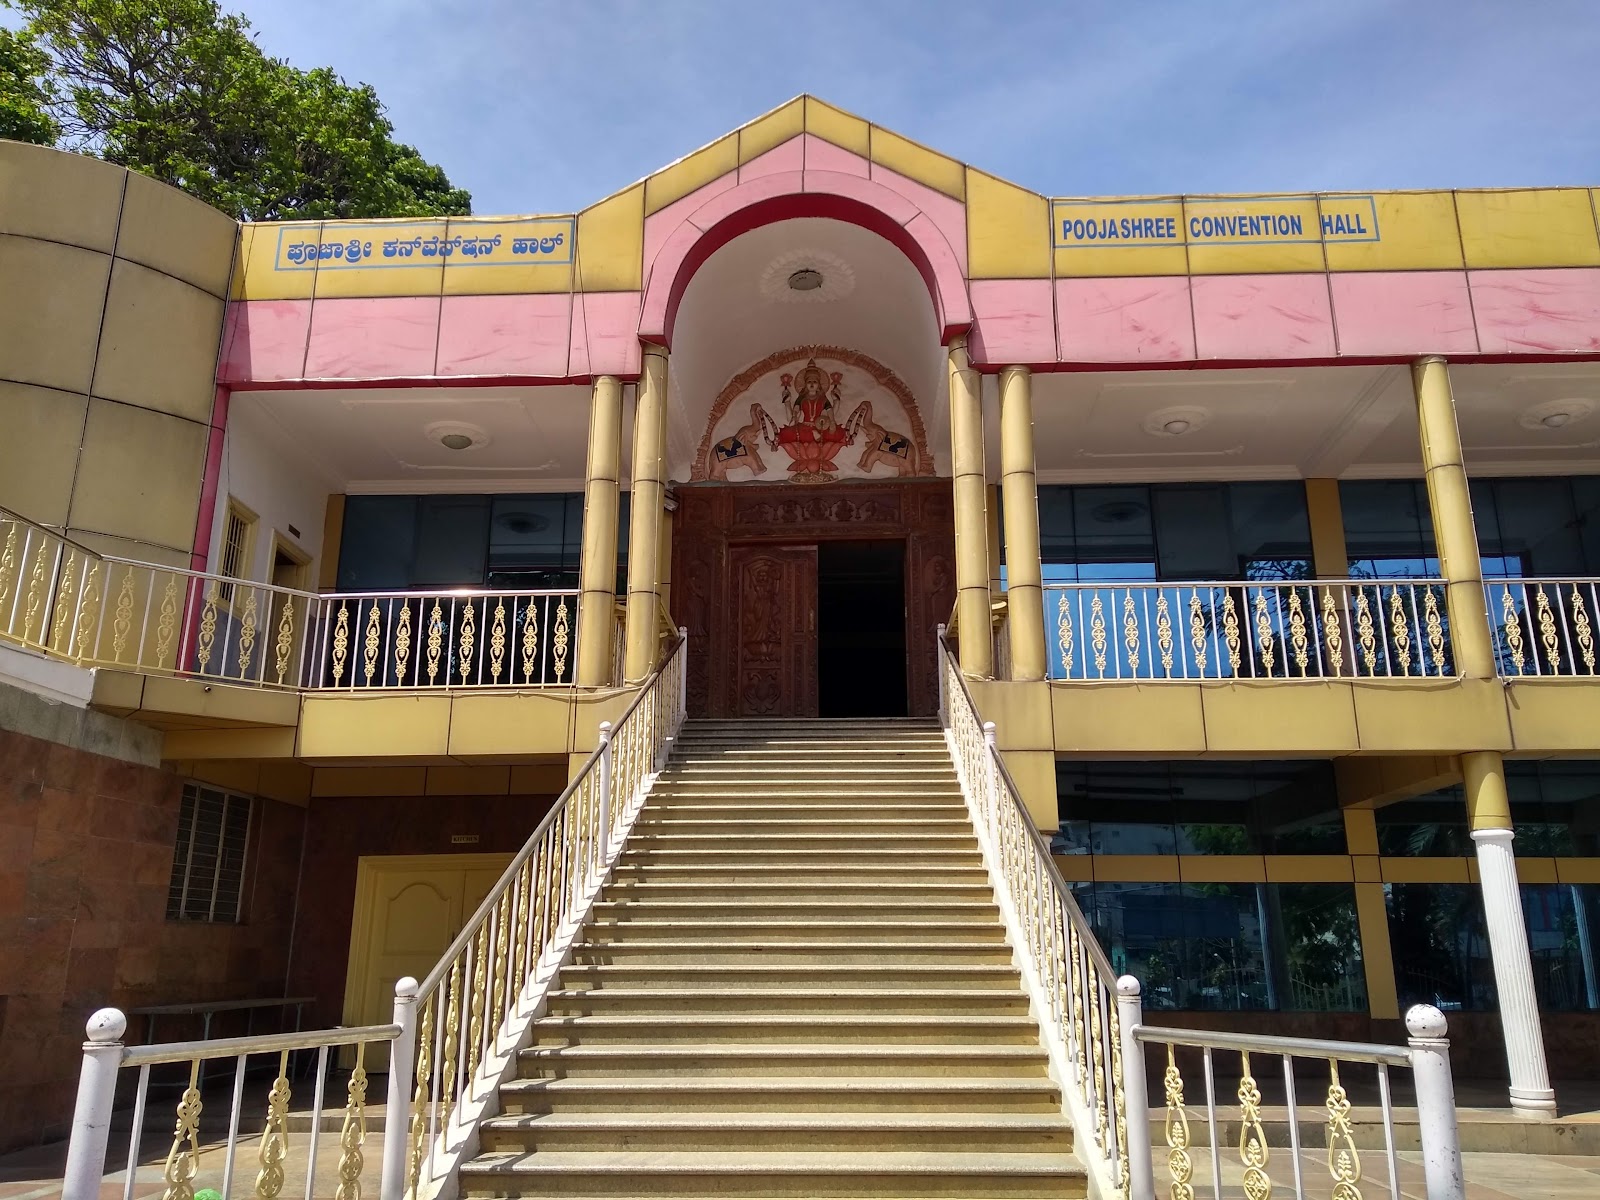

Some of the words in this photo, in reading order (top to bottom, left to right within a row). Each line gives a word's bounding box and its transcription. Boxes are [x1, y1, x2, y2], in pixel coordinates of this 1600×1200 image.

[1062, 218, 1176, 240] POOJASHREE
[1189, 214, 1303, 237] CONVENTION
[1321, 213, 1367, 235] HALL
[287, 239, 372, 264] ಪೂಜಾಶ್ರೀ
[512, 232, 564, 254] ಹಾಲ್
